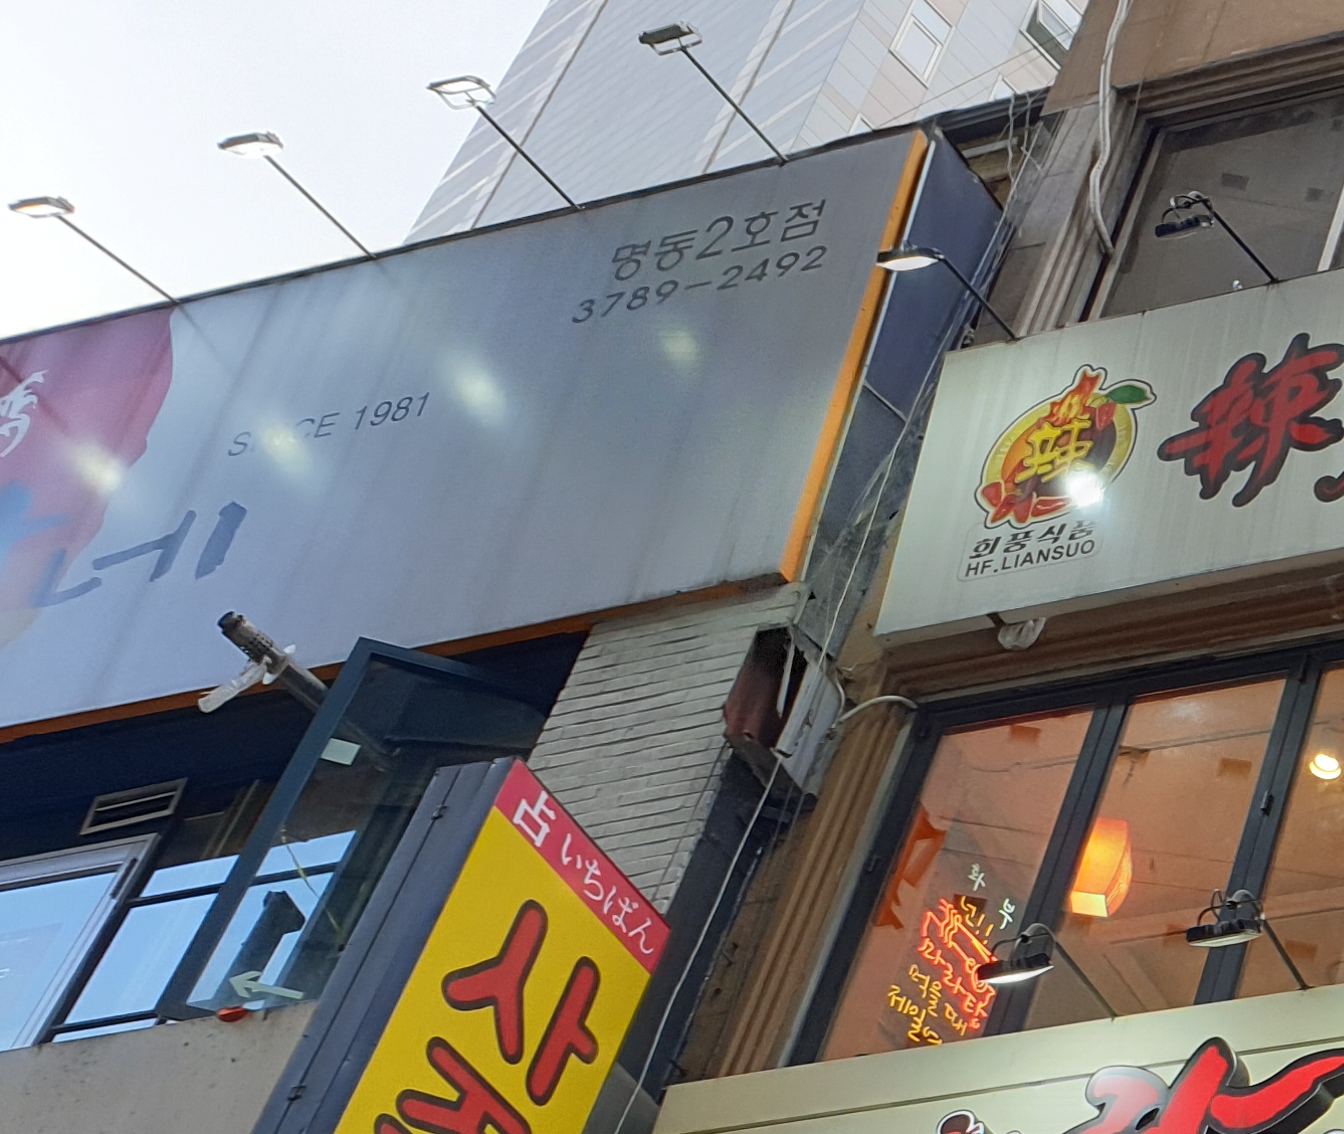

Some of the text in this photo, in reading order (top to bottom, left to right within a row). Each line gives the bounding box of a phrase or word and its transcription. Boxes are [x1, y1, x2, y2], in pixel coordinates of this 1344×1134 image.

[612, 199, 826, 281] 명동2호점
[572, 245, 828, 323] 3789-2492
[354, 391, 430, 431] 1981
[964, 538, 1096, 578] HF.LIANSUO
